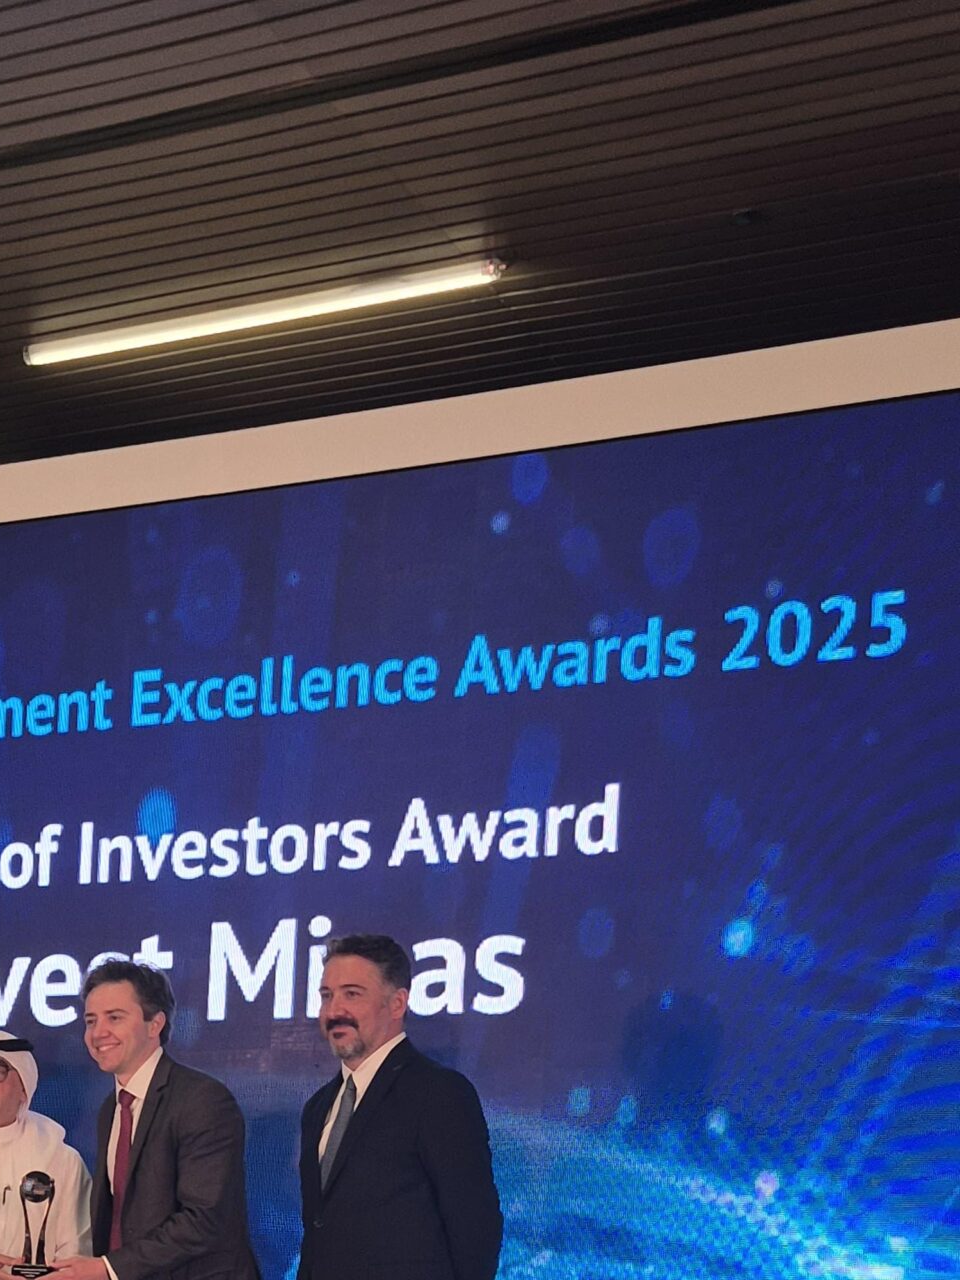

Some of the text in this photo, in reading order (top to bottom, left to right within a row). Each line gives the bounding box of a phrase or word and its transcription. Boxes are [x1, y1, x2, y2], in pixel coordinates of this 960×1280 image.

[130, 654, 440, 728] Excellence
[454, 616, 697, 699] Awards
[721, 589, 908, 673] 2025
[78, 815, 373, 885] Investors
[386, 782, 620, 867] Award
[205, 915, 527, 1021] Mias
